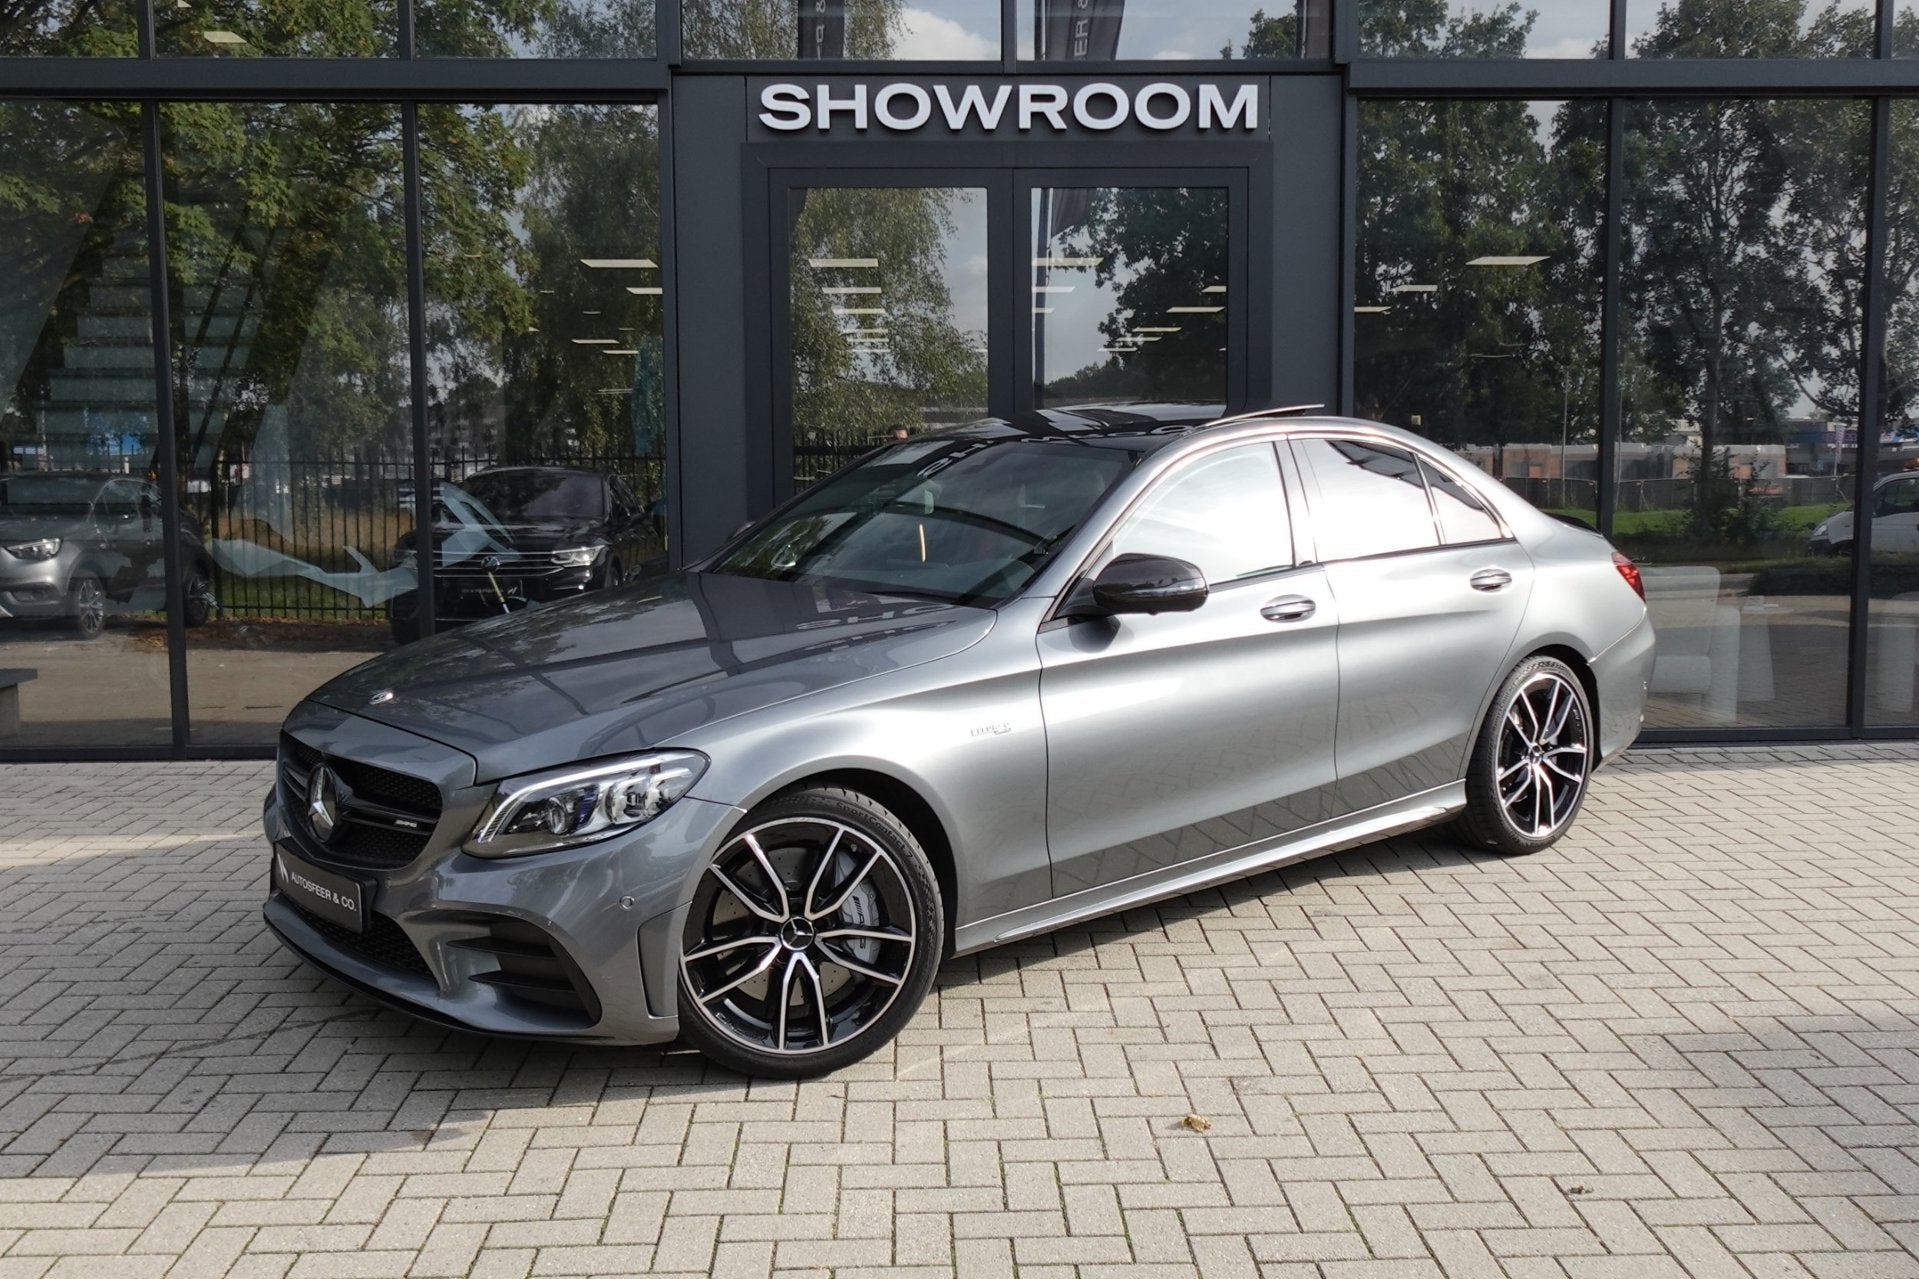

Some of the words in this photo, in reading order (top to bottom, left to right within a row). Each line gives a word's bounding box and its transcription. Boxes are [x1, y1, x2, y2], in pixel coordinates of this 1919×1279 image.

[758, 82, 1259, 130] SHOWROOM
[291, 871, 332, 901] AUTOSFEER
[332, 892, 340, 905] &
[341, 896, 357, 912] CO.
